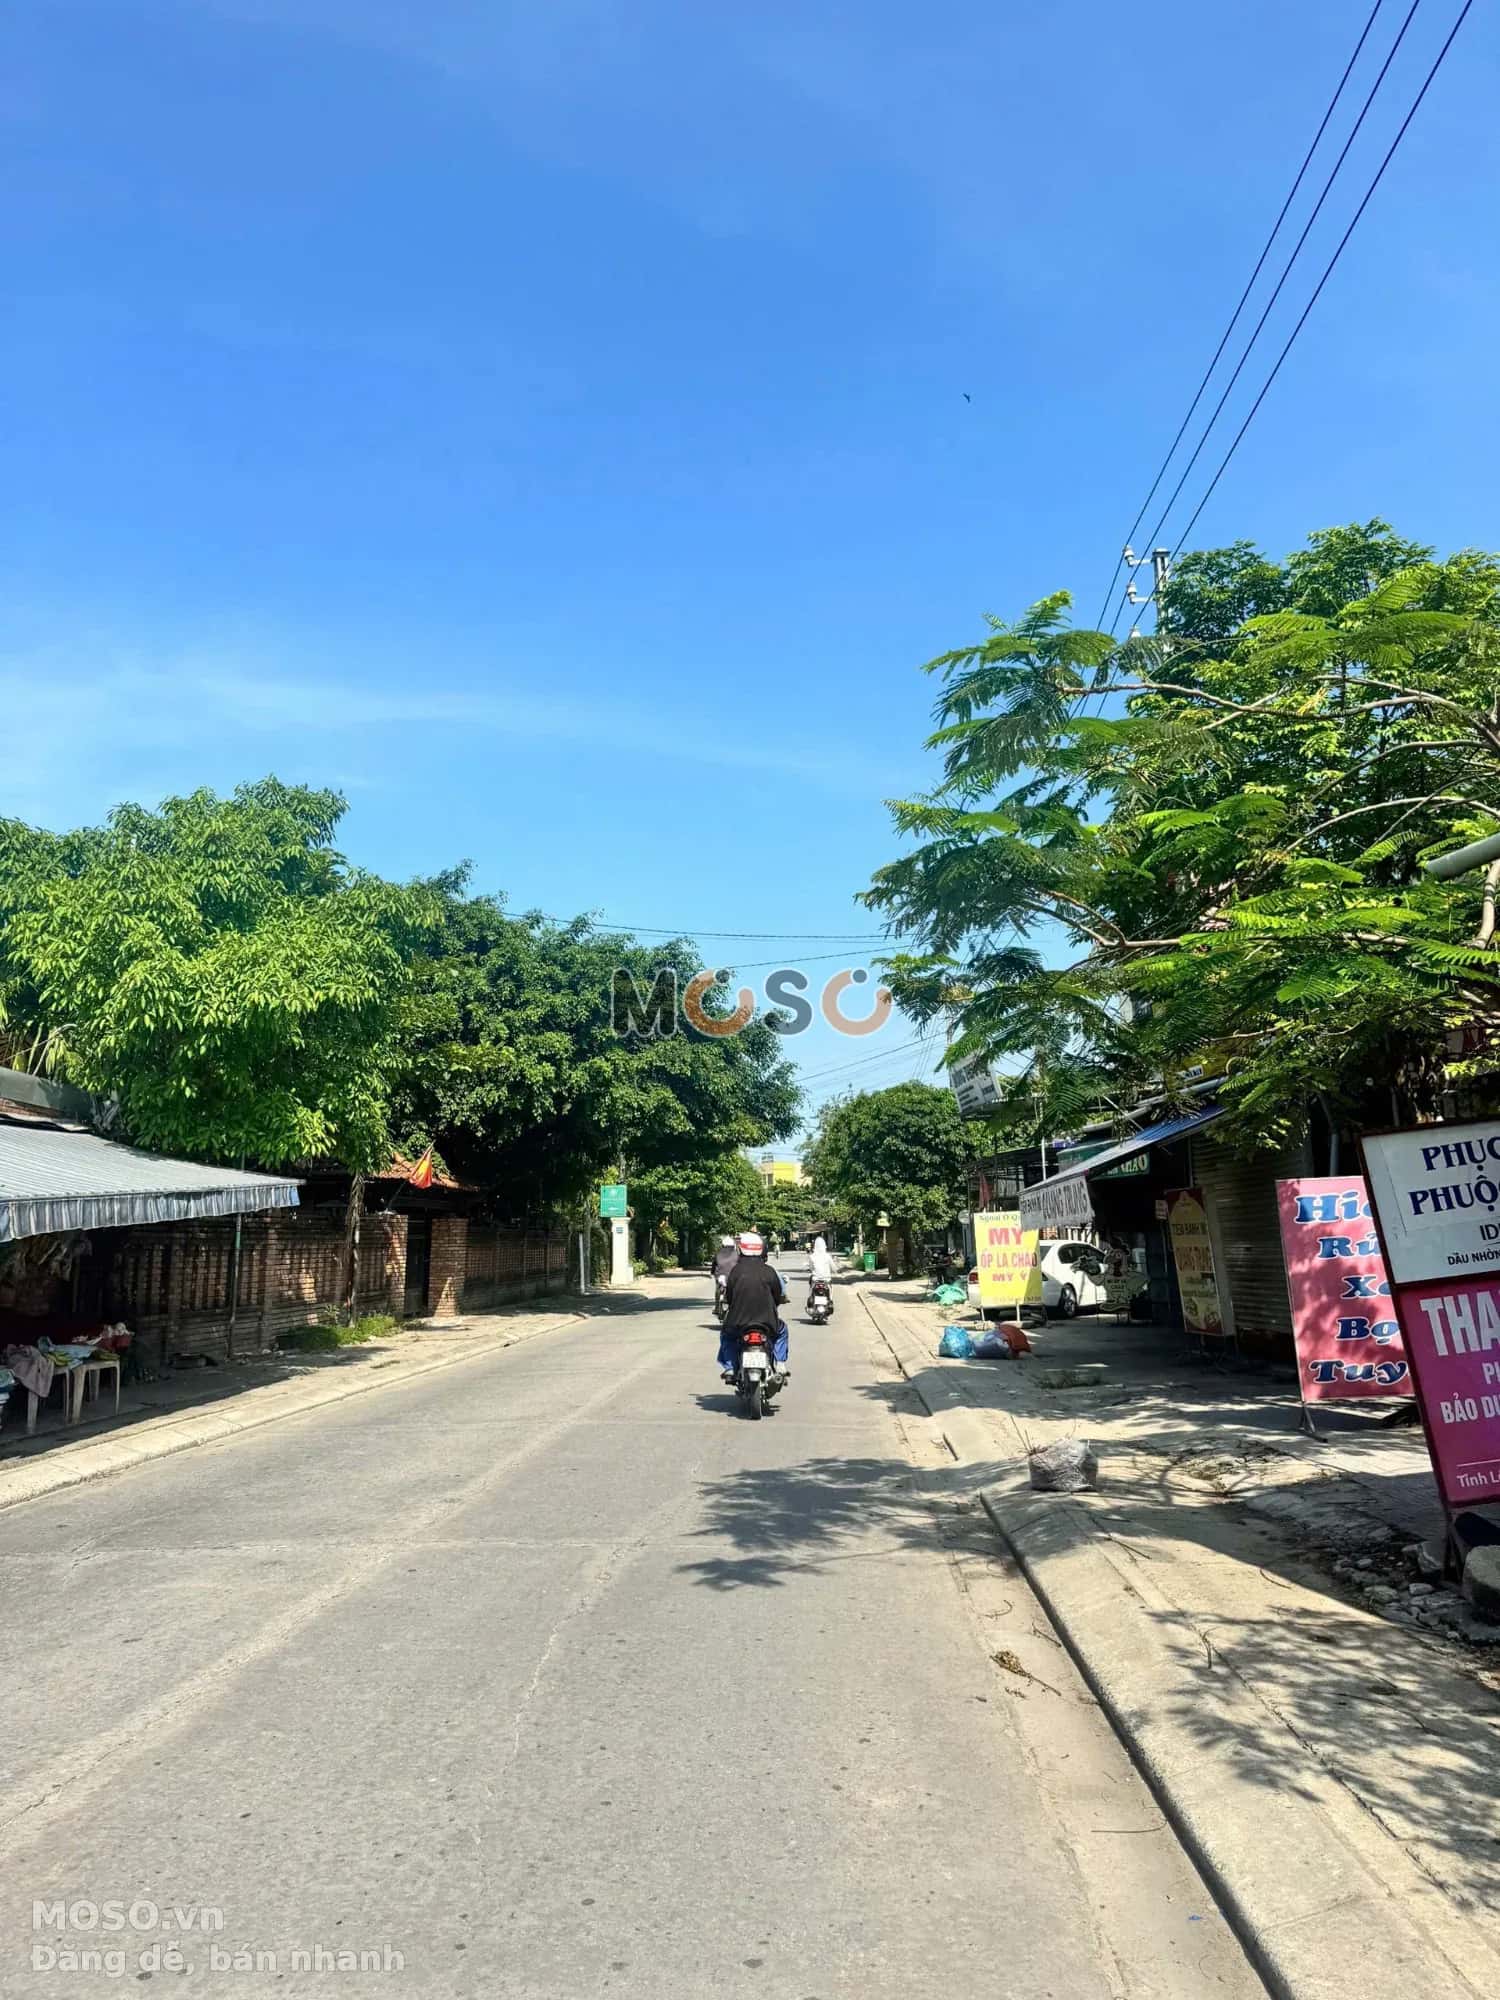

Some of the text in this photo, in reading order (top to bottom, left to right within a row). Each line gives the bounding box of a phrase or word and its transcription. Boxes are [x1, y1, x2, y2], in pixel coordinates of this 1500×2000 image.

[1408, 1175, 1500, 1216] PHUỘ
[1480, 1223, 1500, 1241] ID
[1420, 1291, 1500, 1356] THA
[1440, 1393, 1478, 1424] BẢO
